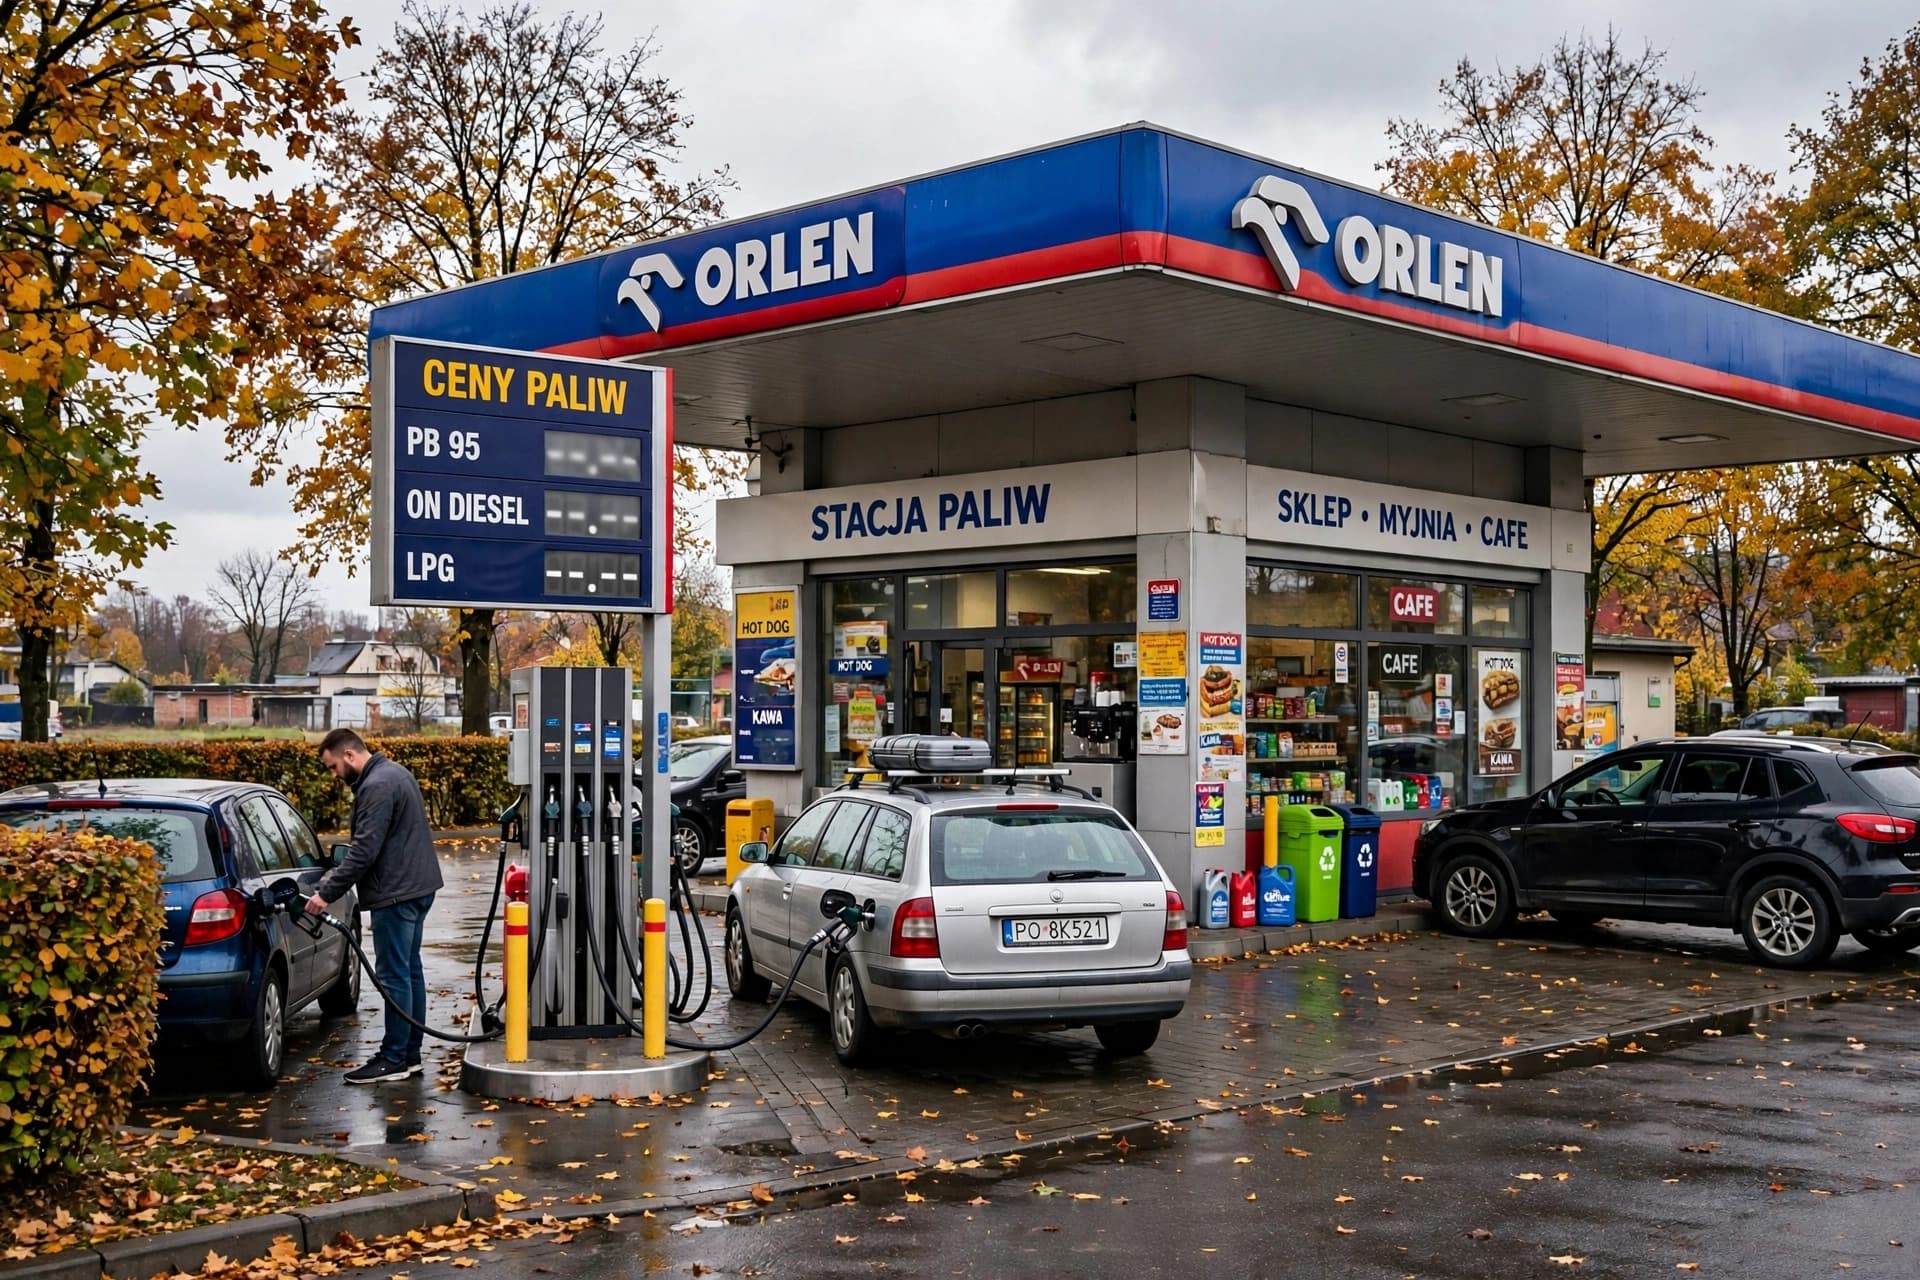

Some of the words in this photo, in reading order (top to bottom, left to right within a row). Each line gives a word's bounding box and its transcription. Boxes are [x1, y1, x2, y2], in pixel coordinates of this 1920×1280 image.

[695, 211, 873, 306] ORLEN
[1335, 215, 1502, 317] ORLEN
[423, 358, 515, 403] CENY
[527, 370, 627, 415] PALIW
[407, 426, 440, 457] PB
[449, 430, 480, 461] 95
[407, 489, 441, 519] ON
[449, 491, 529, 525] DIESEL
[811, 496, 928, 541] STACJA
[938, 483, 1051, 531] PALIW
[1278, 489, 1351, 528] SKLEP
[1379, 503, 1457, 541] MYJNIA
[1480, 516, 1528, 549] CAFE
[407, 551, 455, 582] LPG
[1393, 592, 1434, 617] CAFE
[742, 621, 763, 634] HOT
[766, 620, 789, 633] DOG
[838, 660, 853, 672] HOT
[855, 660, 873, 672] DOG
[1382, 653, 1418, 674] CAFE
[752, 709, 783, 725] KAWA
[1015, 922, 1041, 940] PO
[1049, 920, 1102, 939] 8K521
